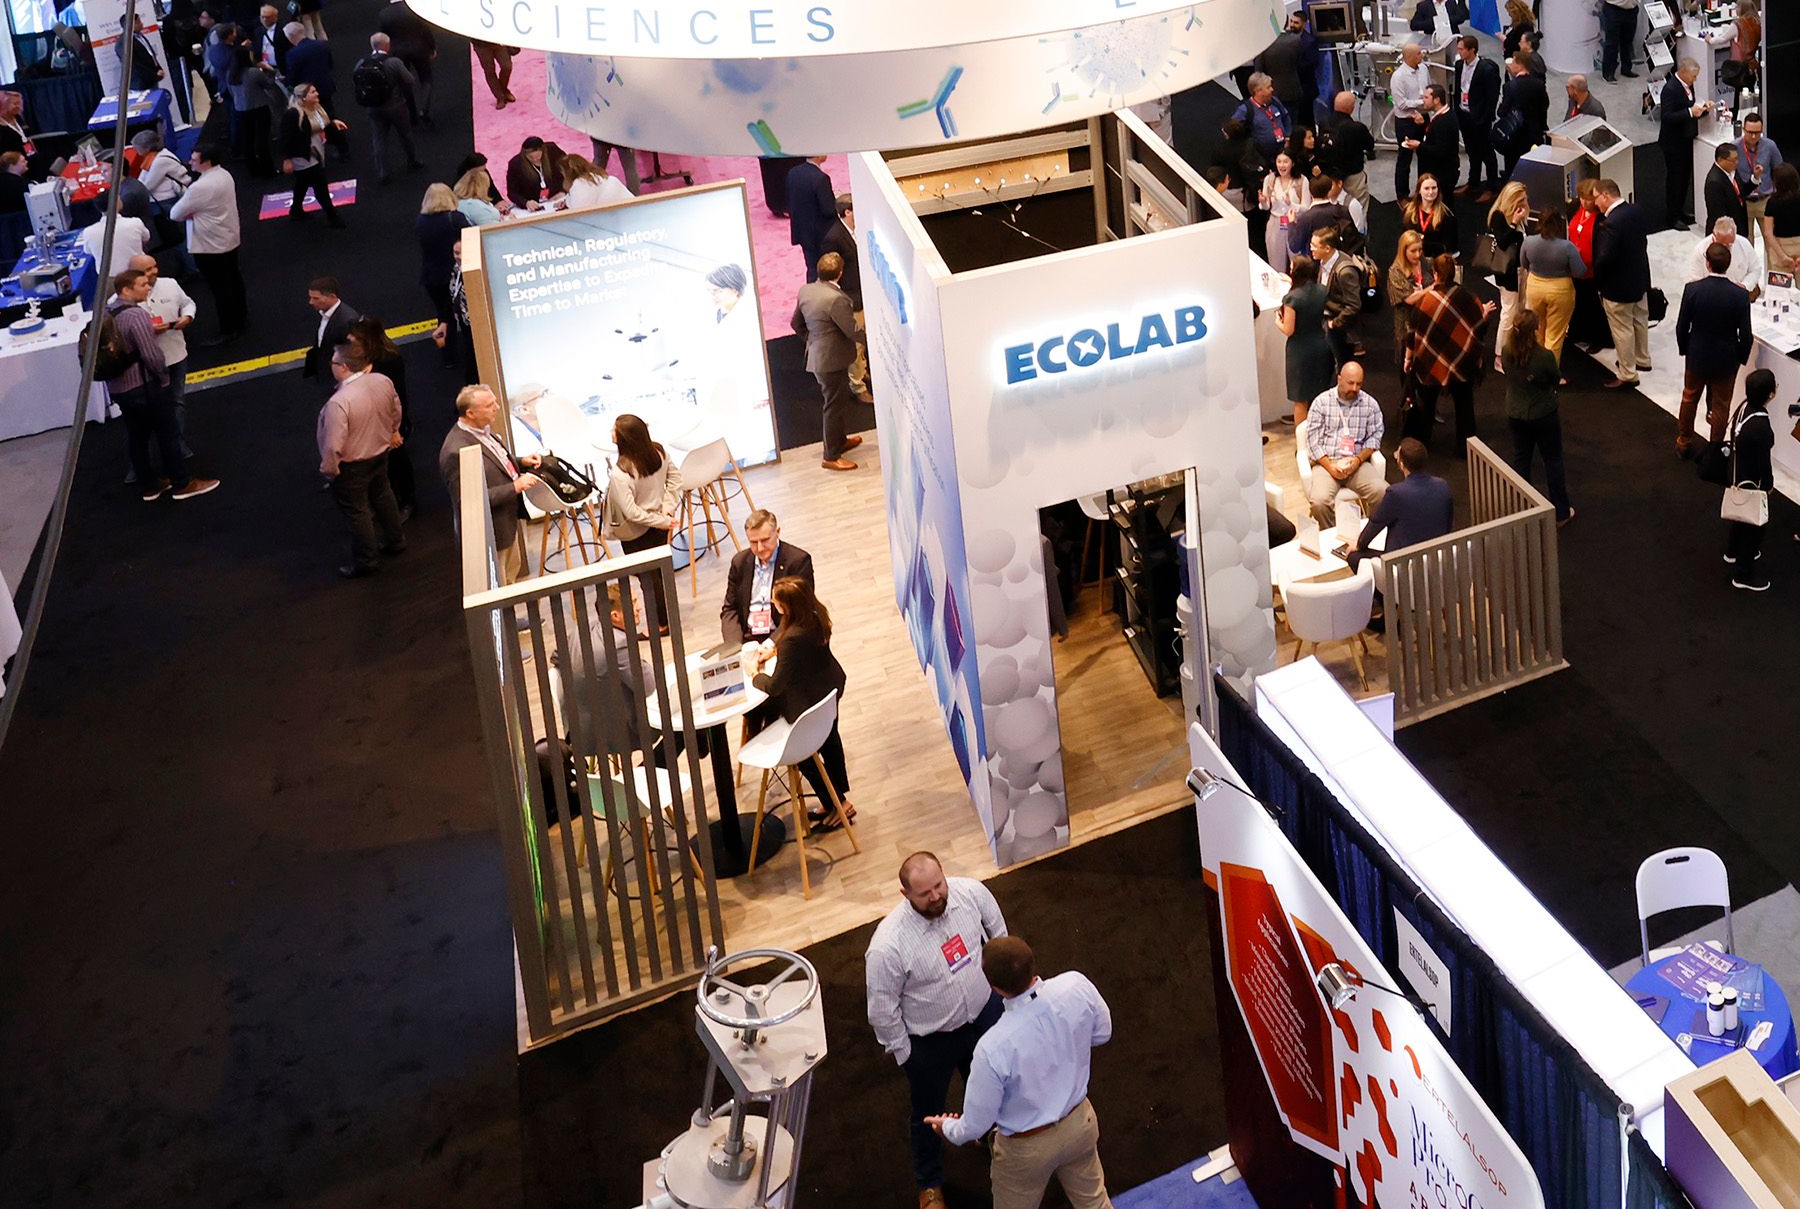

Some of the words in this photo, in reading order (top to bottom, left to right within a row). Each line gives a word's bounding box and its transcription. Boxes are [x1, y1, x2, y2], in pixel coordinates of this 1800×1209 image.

[502, 242, 583, 268] Technical,
[585, 227, 669, 253] Regulatory,
[506, 266, 536, 285] and
[540, 248, 651, 280] Manufacturing
[508, 278, 582, 303] Expertise
[584, 274, 600, 288] to
[511, 302, 552, 320] Time
[554, 297, 571, 311] to
[1004, 305, 1209, 385] ECOLAB
[1408, 941, 1440, 988] ERTELALSOP
[1422, 1073, 1508, 1197] ERTELALSOP
